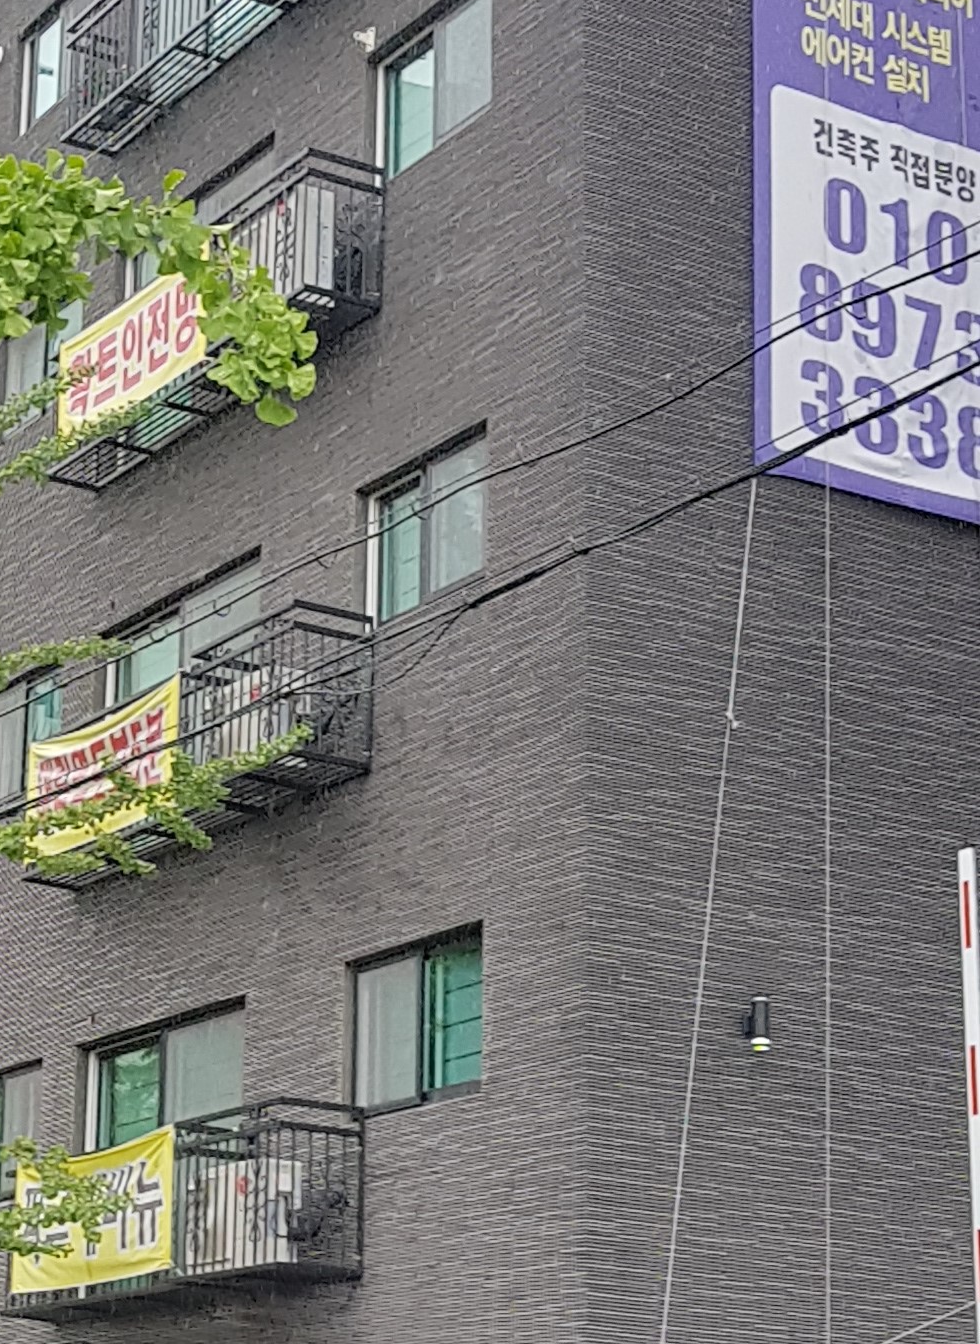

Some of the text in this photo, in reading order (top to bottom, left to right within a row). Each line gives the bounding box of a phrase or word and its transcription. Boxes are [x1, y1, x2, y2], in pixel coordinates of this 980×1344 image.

[800, 26, 930, 104] 에어컨 설치
[882, 10, 952, 66] 시스템
[814, 118, 977, 203] 건축주 직접분양
[825, 177, 969, 286] 010
